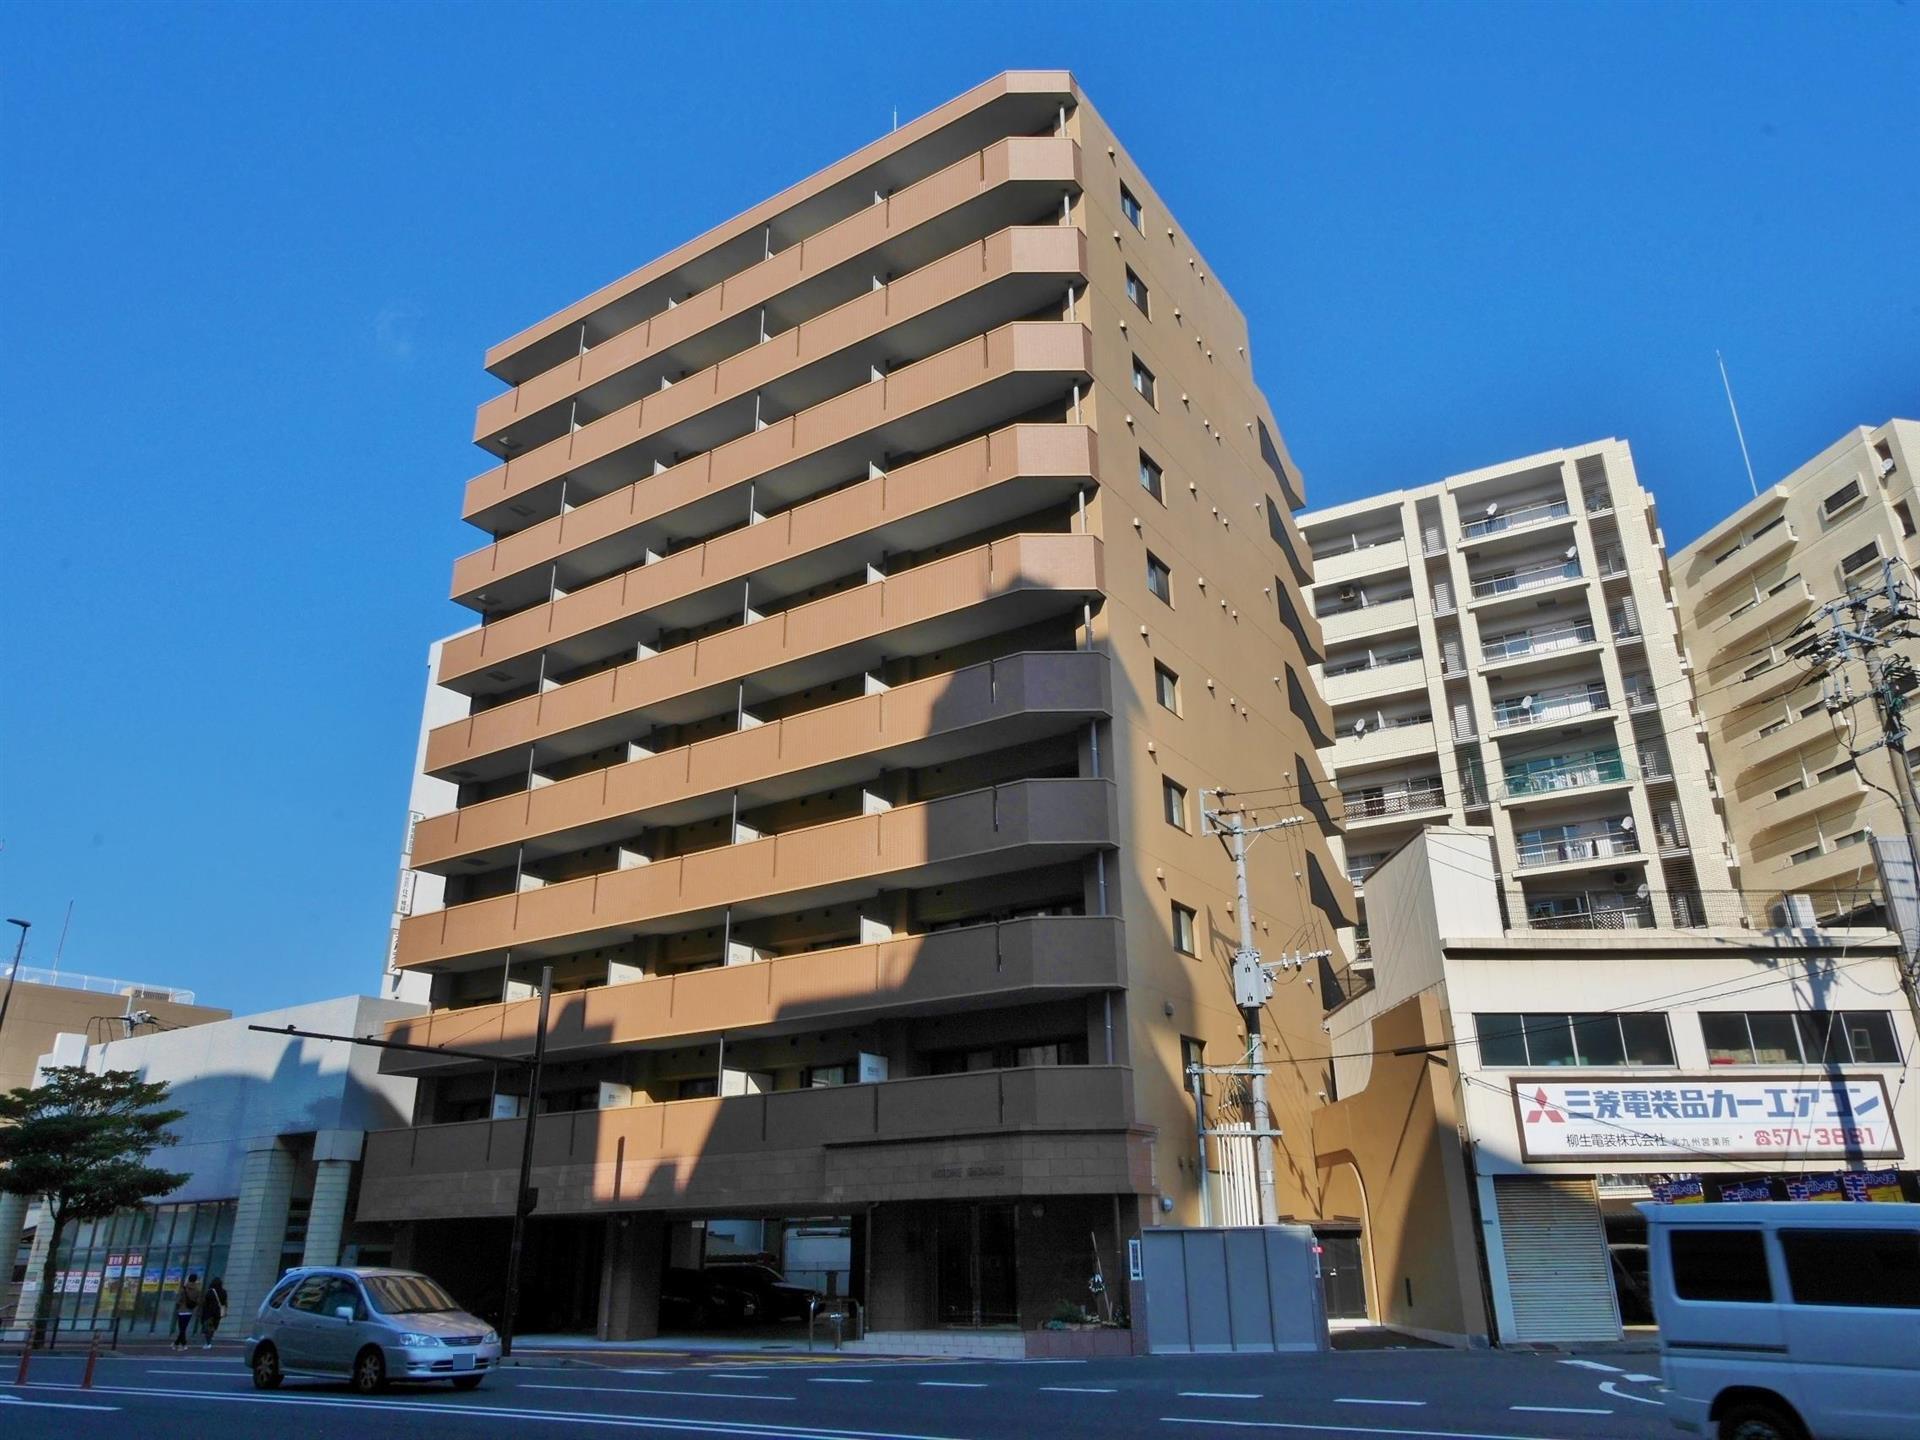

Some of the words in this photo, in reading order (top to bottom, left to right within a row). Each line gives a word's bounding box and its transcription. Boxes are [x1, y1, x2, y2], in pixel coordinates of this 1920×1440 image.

[1564, 1088, 1879, 1119] 三菱電装品カーエアコン
[1566, 1132, 1666, 1148] 柳生電装株式会社
[1771, 1127, 1876, 1146] 571-3881
